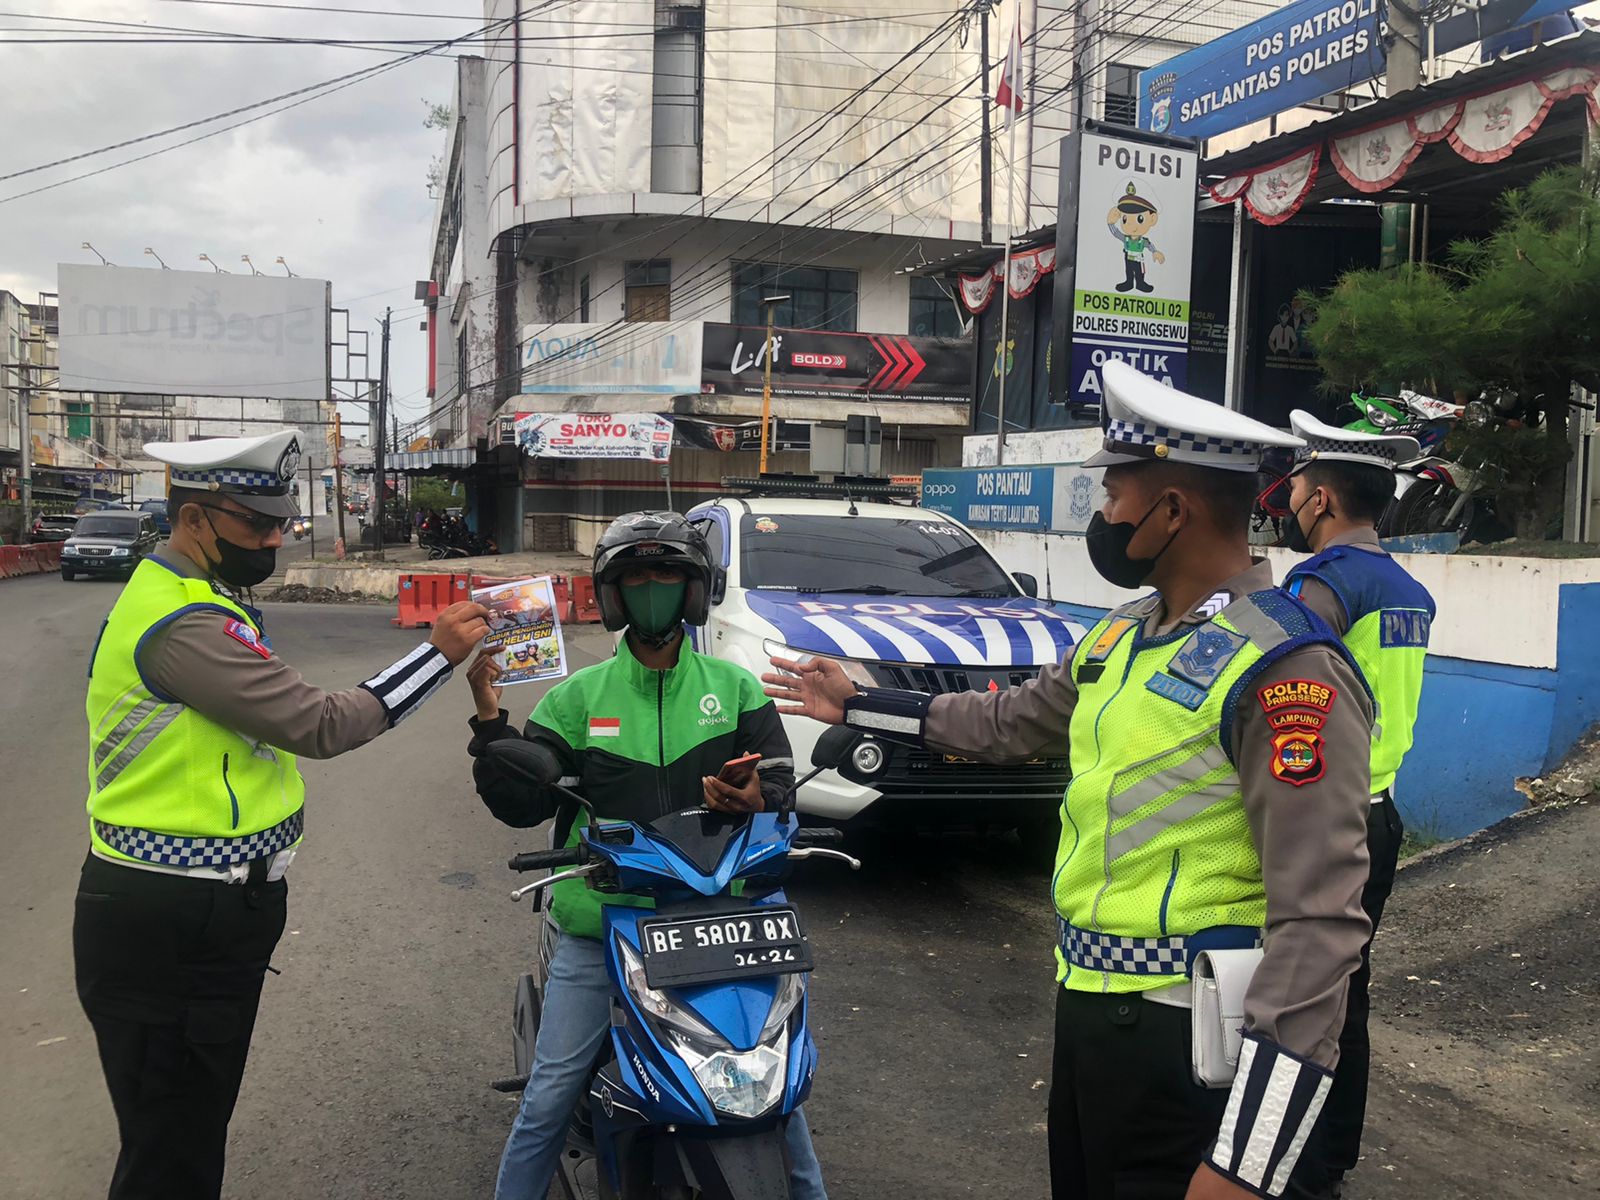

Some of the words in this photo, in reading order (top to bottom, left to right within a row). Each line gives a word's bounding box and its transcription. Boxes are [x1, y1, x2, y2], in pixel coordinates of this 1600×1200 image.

[1246, 32, 1284, 66] POS
[1179, 65, 1281, 123] SATLANTAS
[1286, 29, 1369, 82] POLRES
[1097, 143, 1183, 179] POLISI
[1083, 293, 1111, 311] POS
[1113, 295, 1166, 317] PATROLI
[1168, 303, 1182, 318] 02
[1075, 315, 1119, 333] POLRES
[1120, 320, 1188, 340] PRINGSEWU
[526, 337, 600, 360] AQUA
[793, 353, 833, 366] BOLD
[1090, 349, 1169, 373] OPTIK
[576, 413, 612, 423] TOKO
[560, 423, 627, 438] SANYO
[924, 484, 956, 497] oppo
[976, 473, 994, 496] POS
[995, 471, 1033, 496] PANTAU
[968, 504, 991, 522] KAWASAN
[990, 504, 1008, 523] TERTIB
[1007, 505, 1021, 524] LALU
[1021, 504, 1040, 524] LINTAS
[918, 525, 960, 536] 14-03
[798, 600, 1063, 620] POLISI
[503, 632, 531, 646] HELM
[533, 628, 552, 640] SNI
[1263, 682, 1330, 700] POLRES
[1266, 692, 1328, 708] PRINGSEWU
[1273, 713, 1320, 726] LAMPUNG
[652, 929, 684, 953] BE
[694, 920, 753, 947] 5802
[633, 1053, 661, 1103] HONDA
